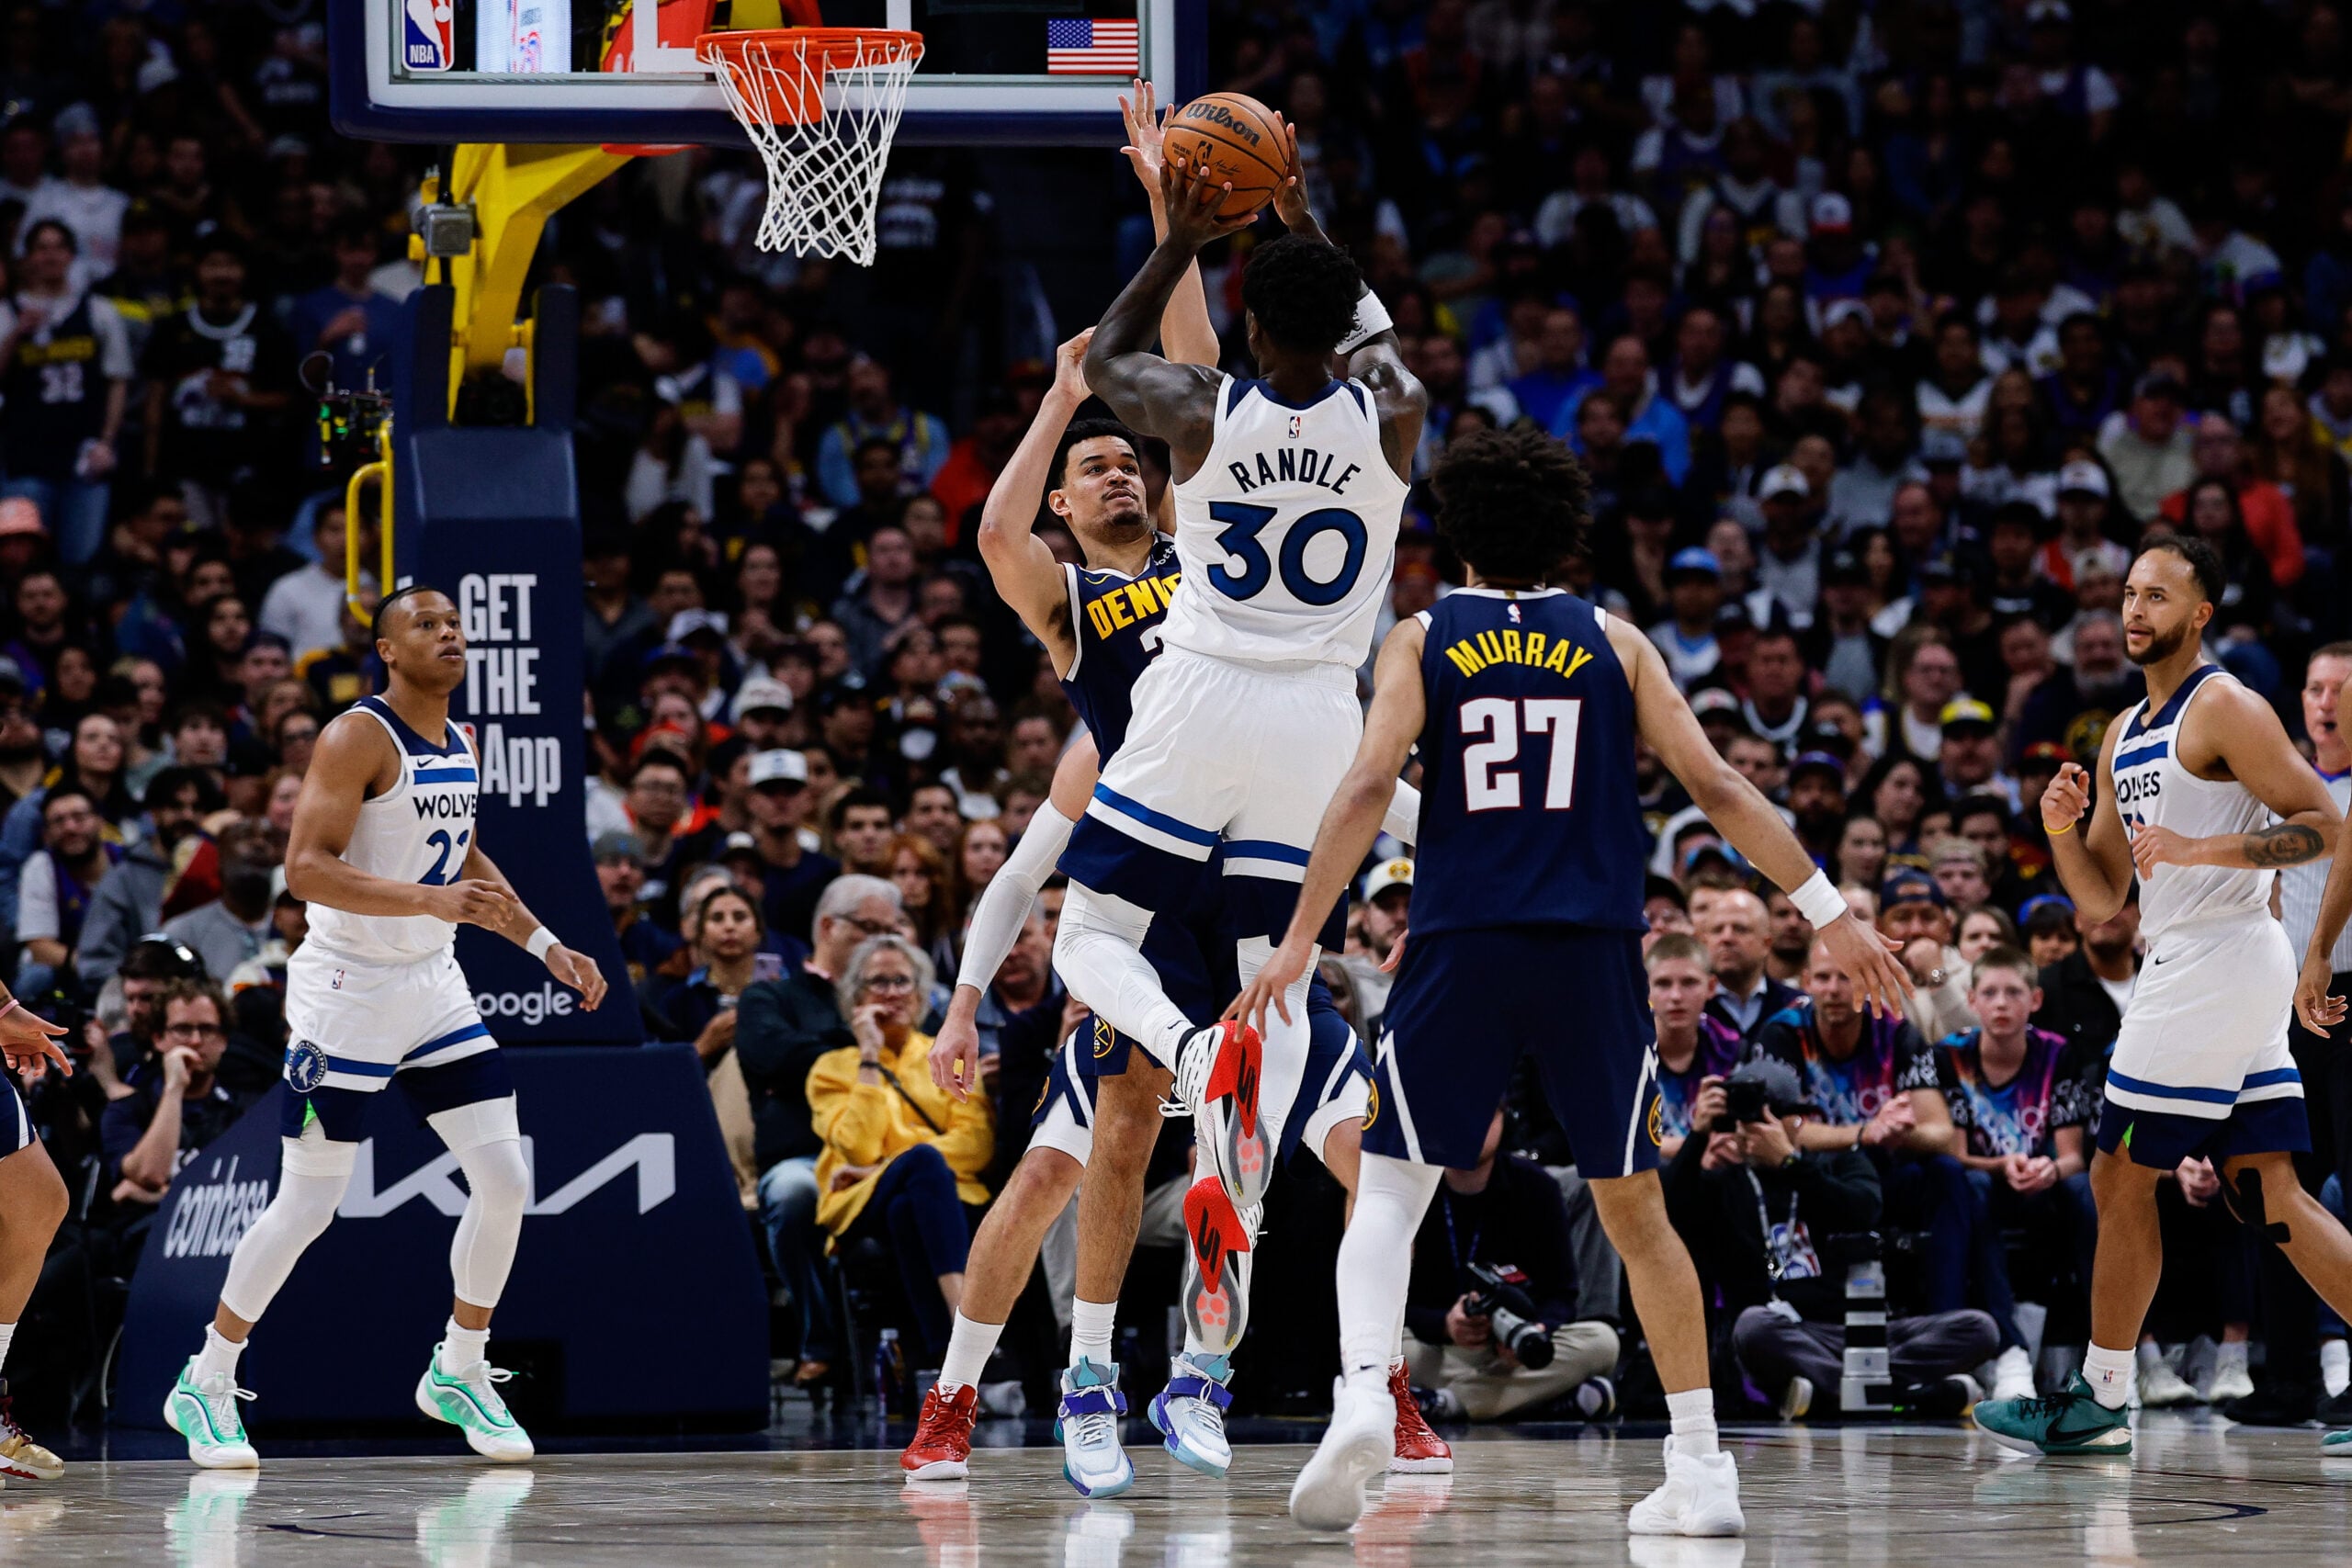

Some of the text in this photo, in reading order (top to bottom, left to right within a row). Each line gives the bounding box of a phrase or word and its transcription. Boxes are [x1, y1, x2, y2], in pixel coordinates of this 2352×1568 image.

[410, 44, 435, 64] NBA
[1186, 102, 1261, 149] Wilson
[1228, 447, 1362, 496] RANDLE
[1206, 501, 1368, 606] 30
[458, 573, 537, 642] GET
[1086, 572, 1182, 641] DENV
[464, 647, 542, 716] THE
[1444, 629, 1594, 679] MURRAY
[481, 723, 561, 807] App
[1459, 696, 1583, 813] 27
[413, 793, 477, 820] WOLVE
[470, 980, 573, 1026] oogle
